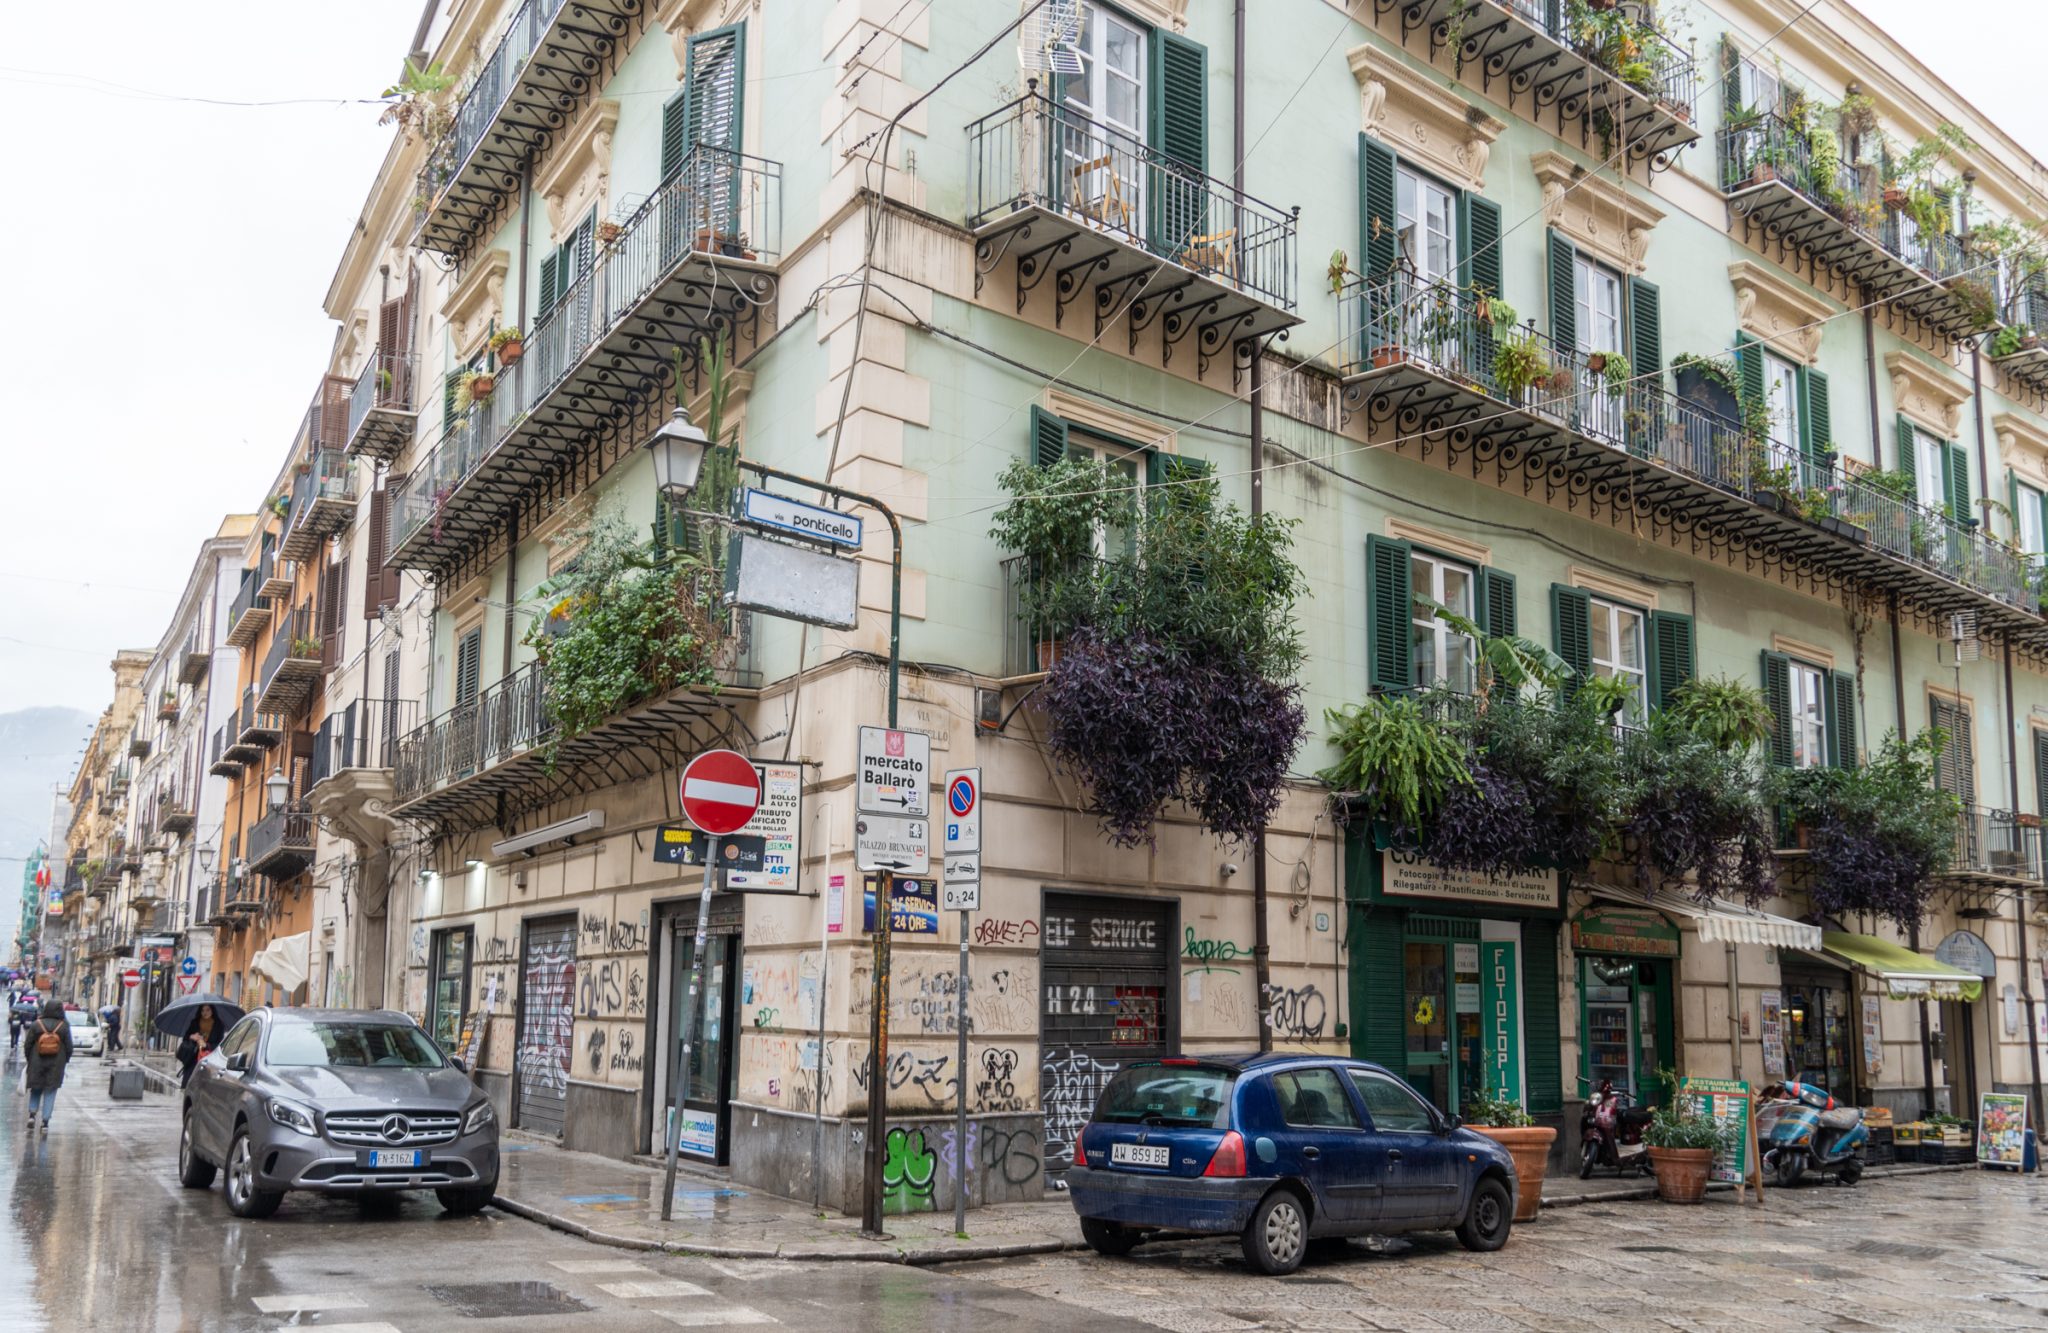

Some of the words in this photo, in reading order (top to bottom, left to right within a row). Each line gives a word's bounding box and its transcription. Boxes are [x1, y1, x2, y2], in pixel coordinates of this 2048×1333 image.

[774, 512, 785, 522] via
[793, 514, 853, 539] ponticello
[917, 710, 930, 722] VIA
[864, 755, 923, 773] mercato
[864, 769, 916, 789] Ballarò
[751, 816, 787, 826] NIFICATO
[756, 808, 792, 818] TRIBUTO
[860, 839, 887, 851] PALAZZO
[888, 841, 926, 855] BRUNACCINI
[769, 865, 791, 875] AST
[1398, 868, 1439, 880] Fotocopie
[1511, 880, 1519, 888] di
[1520, 881, 1546, 891] Laurea
[946, 891, 954, 903] 0
[962, 890, 975, 902] 24
[1443, 884, 1499, 897] Plastificazioni
[1504, 889, 1535, 901] Servizio
[1536, 893, 1551, 902] FAX
[891, 896, 904, 913] ELF
[905, 895, 937, 913] SERVICE
[894, 914, 907, 930] 24
[908, 914, 928, 932] ORE
[1090, 917, 1156, 949] SERVICE
[1047, 986, 1061, 1014] H
[1069, 985, 1096, 1015] 24
[1494, 948, 1509, 1105] FOTOCOPIE
[682, 1119, 715, 1134] ycamobile
[1114, 1145, 1127, 1159] AW
[1131, 1147, 1151, 1163] 859
[1154, 1150, 1168, 1165] BE
[1182, 1157, 1197, 1166] Clio
